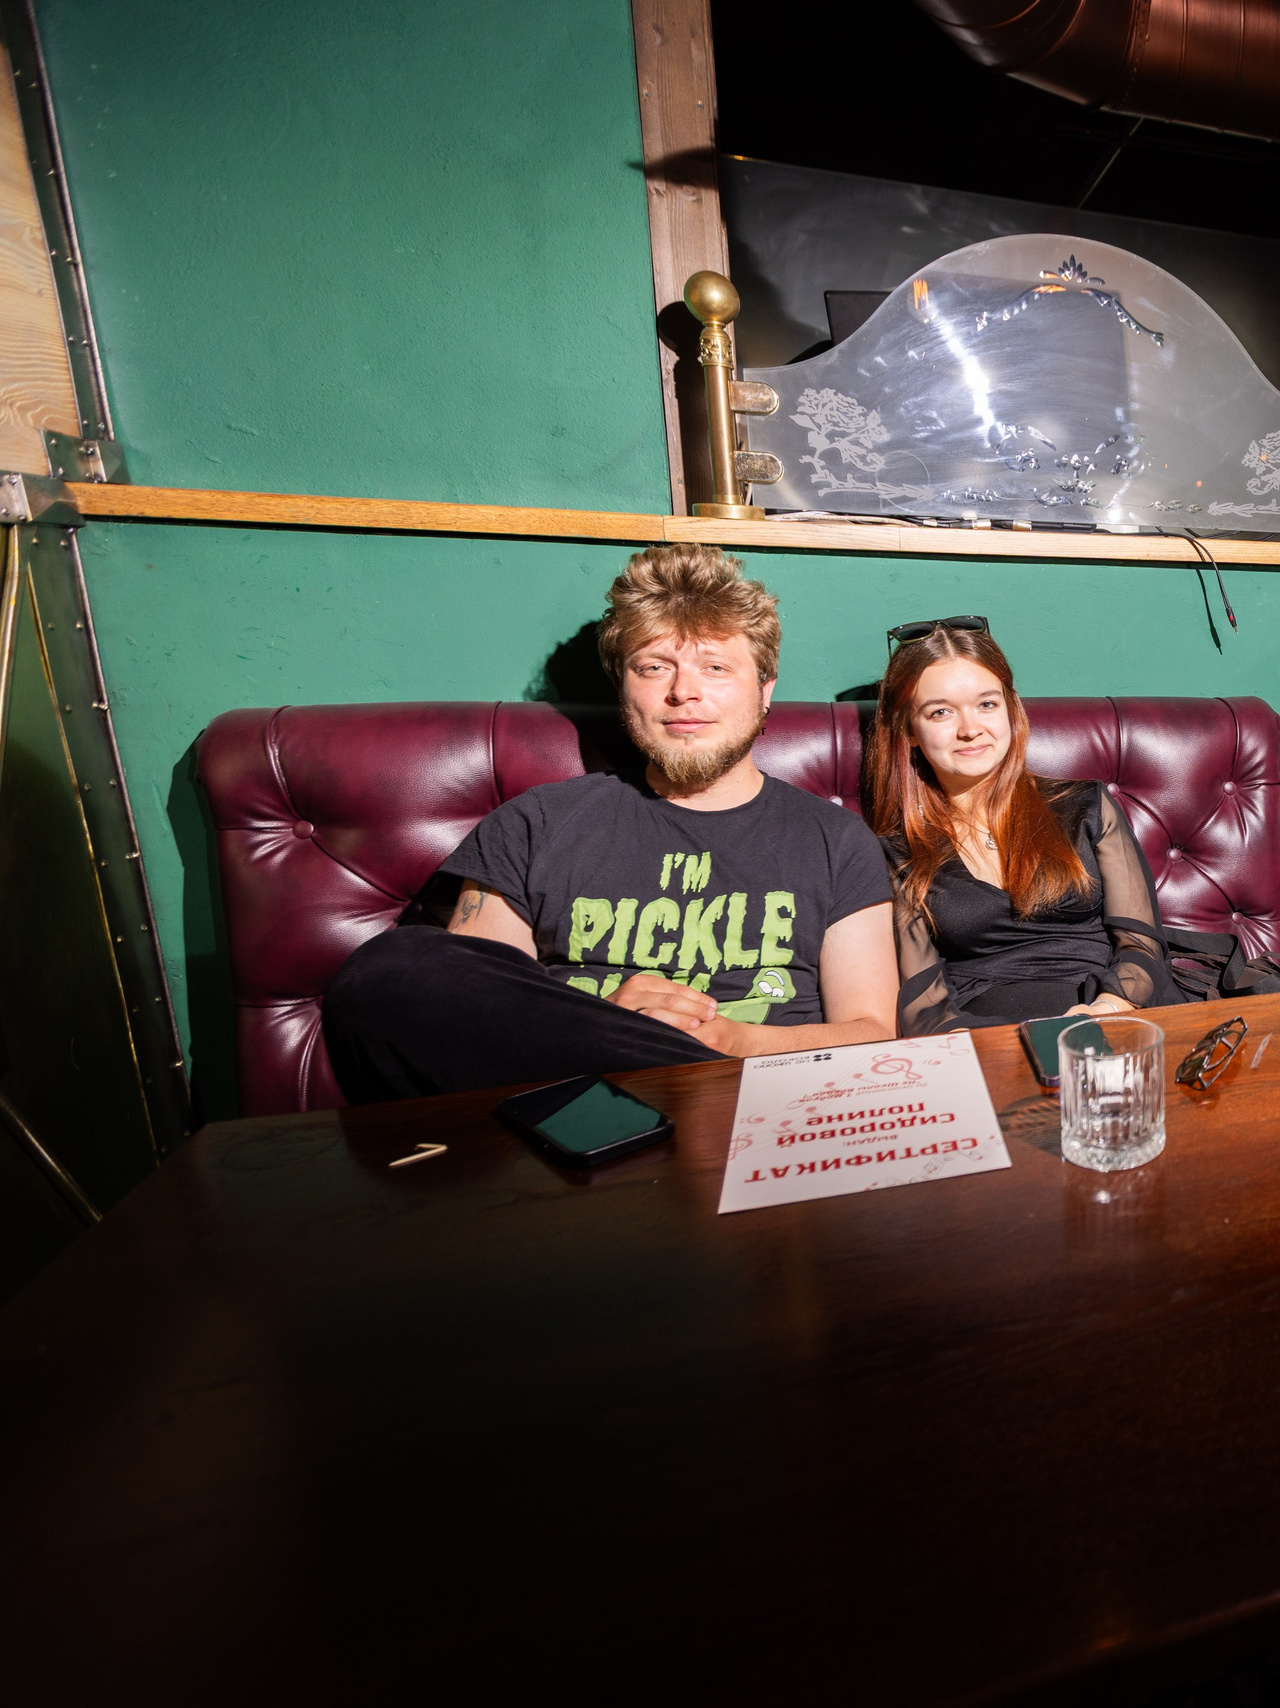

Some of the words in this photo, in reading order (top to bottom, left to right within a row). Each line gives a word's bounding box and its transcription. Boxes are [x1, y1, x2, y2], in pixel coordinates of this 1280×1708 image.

[659, 851, 711, 894] I'M
[568, 890, 796, 975] PICKLE
[744, 1137, 978, 1182] СЕРТИФИКАТ
